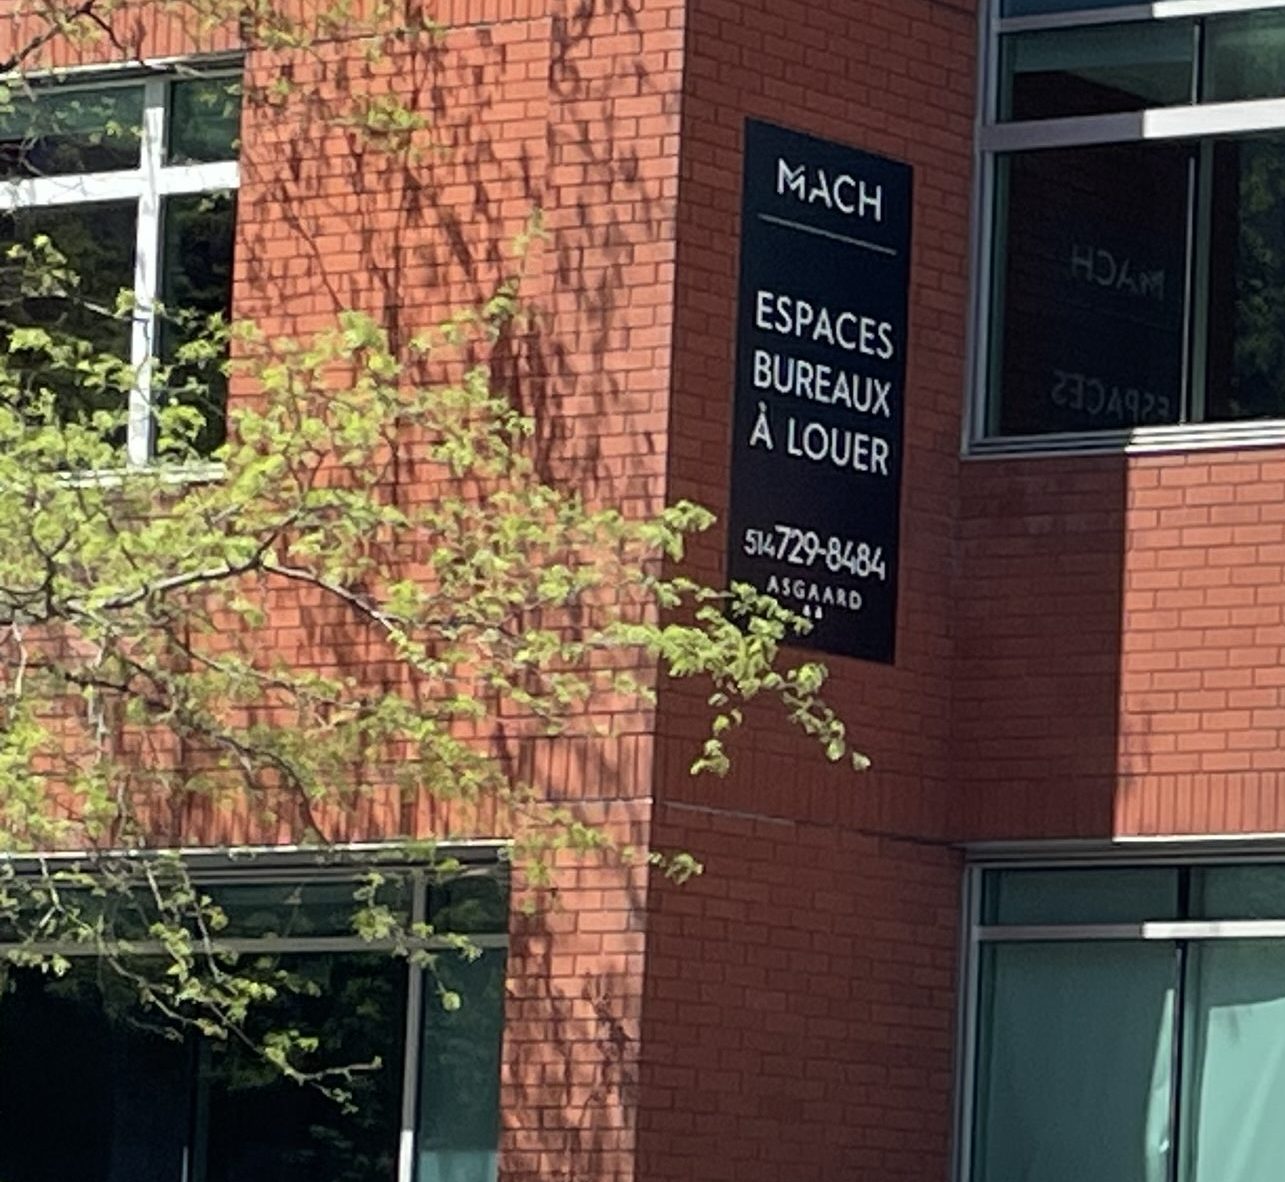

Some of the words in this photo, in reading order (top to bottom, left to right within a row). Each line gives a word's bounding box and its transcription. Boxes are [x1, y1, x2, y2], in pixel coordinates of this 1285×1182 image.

[776, 157, 882, 222] MACH
[756, 290, 894, 360] ESPACES
[753, 350, 892, 418] BUREAUX
[749, 401, 774, 451] À
[787, 417, 889, 476] LOUER
[766, 575, 863, 610] ASGAARD
